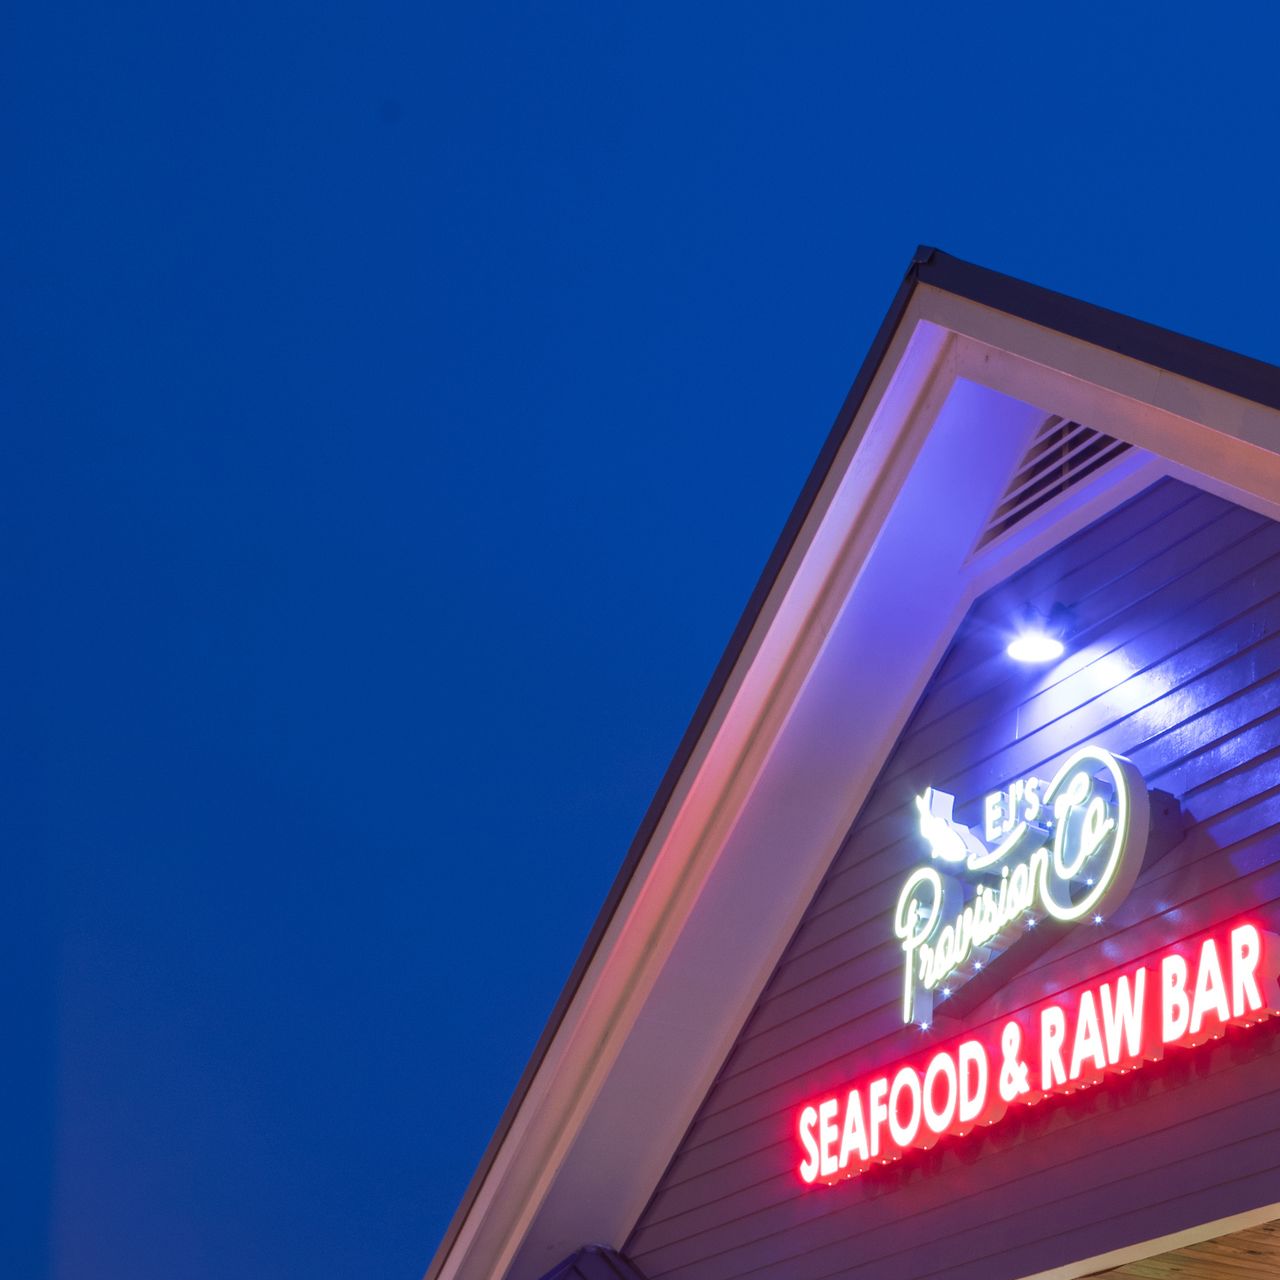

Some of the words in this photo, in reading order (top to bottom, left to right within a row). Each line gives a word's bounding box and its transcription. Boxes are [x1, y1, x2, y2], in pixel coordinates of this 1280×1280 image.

[984, 776, 1041, 842] EJ'S
[894, 846, 1054, 1024] Provision
[799, 1040, 989, 1183] SEAFOOD
[999, 1021, 1031, 1102] &
[1040, 966, 1147, 1091] RAW
[1161, 923, 1264, 1044] BAR
